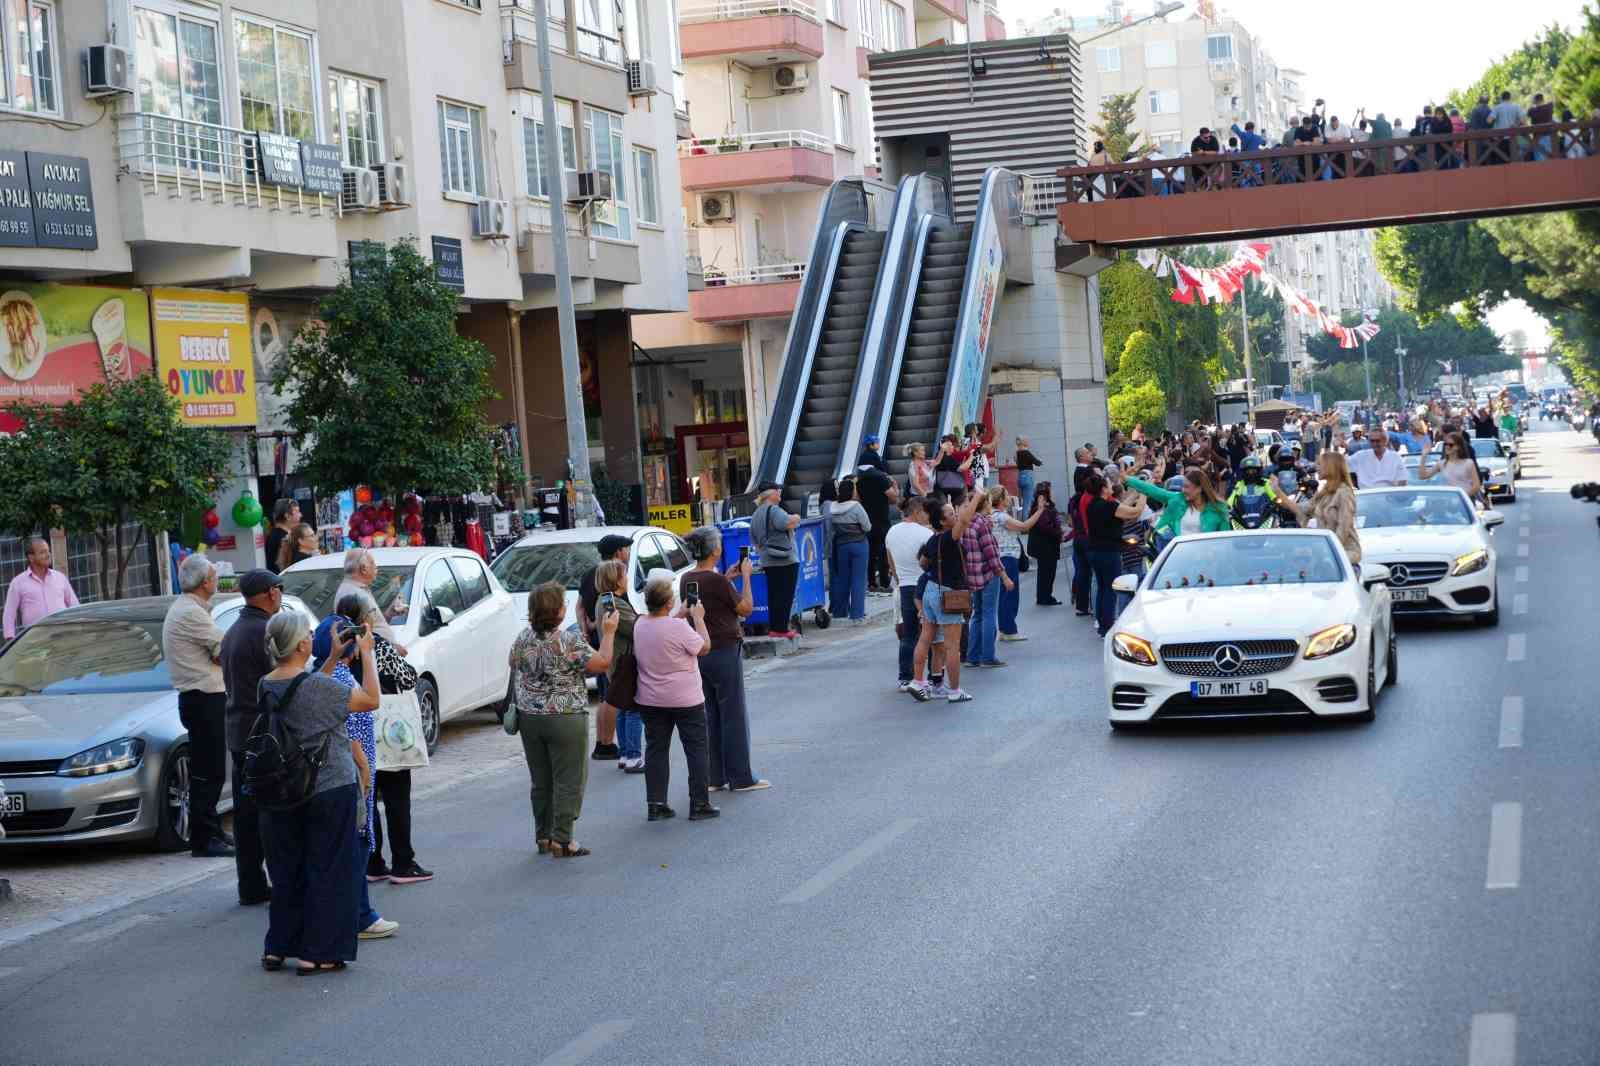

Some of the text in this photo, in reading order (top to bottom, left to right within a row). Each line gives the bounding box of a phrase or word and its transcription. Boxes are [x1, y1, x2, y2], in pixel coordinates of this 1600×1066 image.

[43, 163, 81, 182] AVUKAT
[5, 188, 31, 208] PALA
[36, 187, 75, 212] YAĞMUR
[167, 367, 246, 396] OYUNCAK
[649, 508, 687, 521] MLER
[1199, 683, 1212, 696] 07
[1220, 682, 1241, 695] MMT
[1249, 681, 1264, 695] 48
